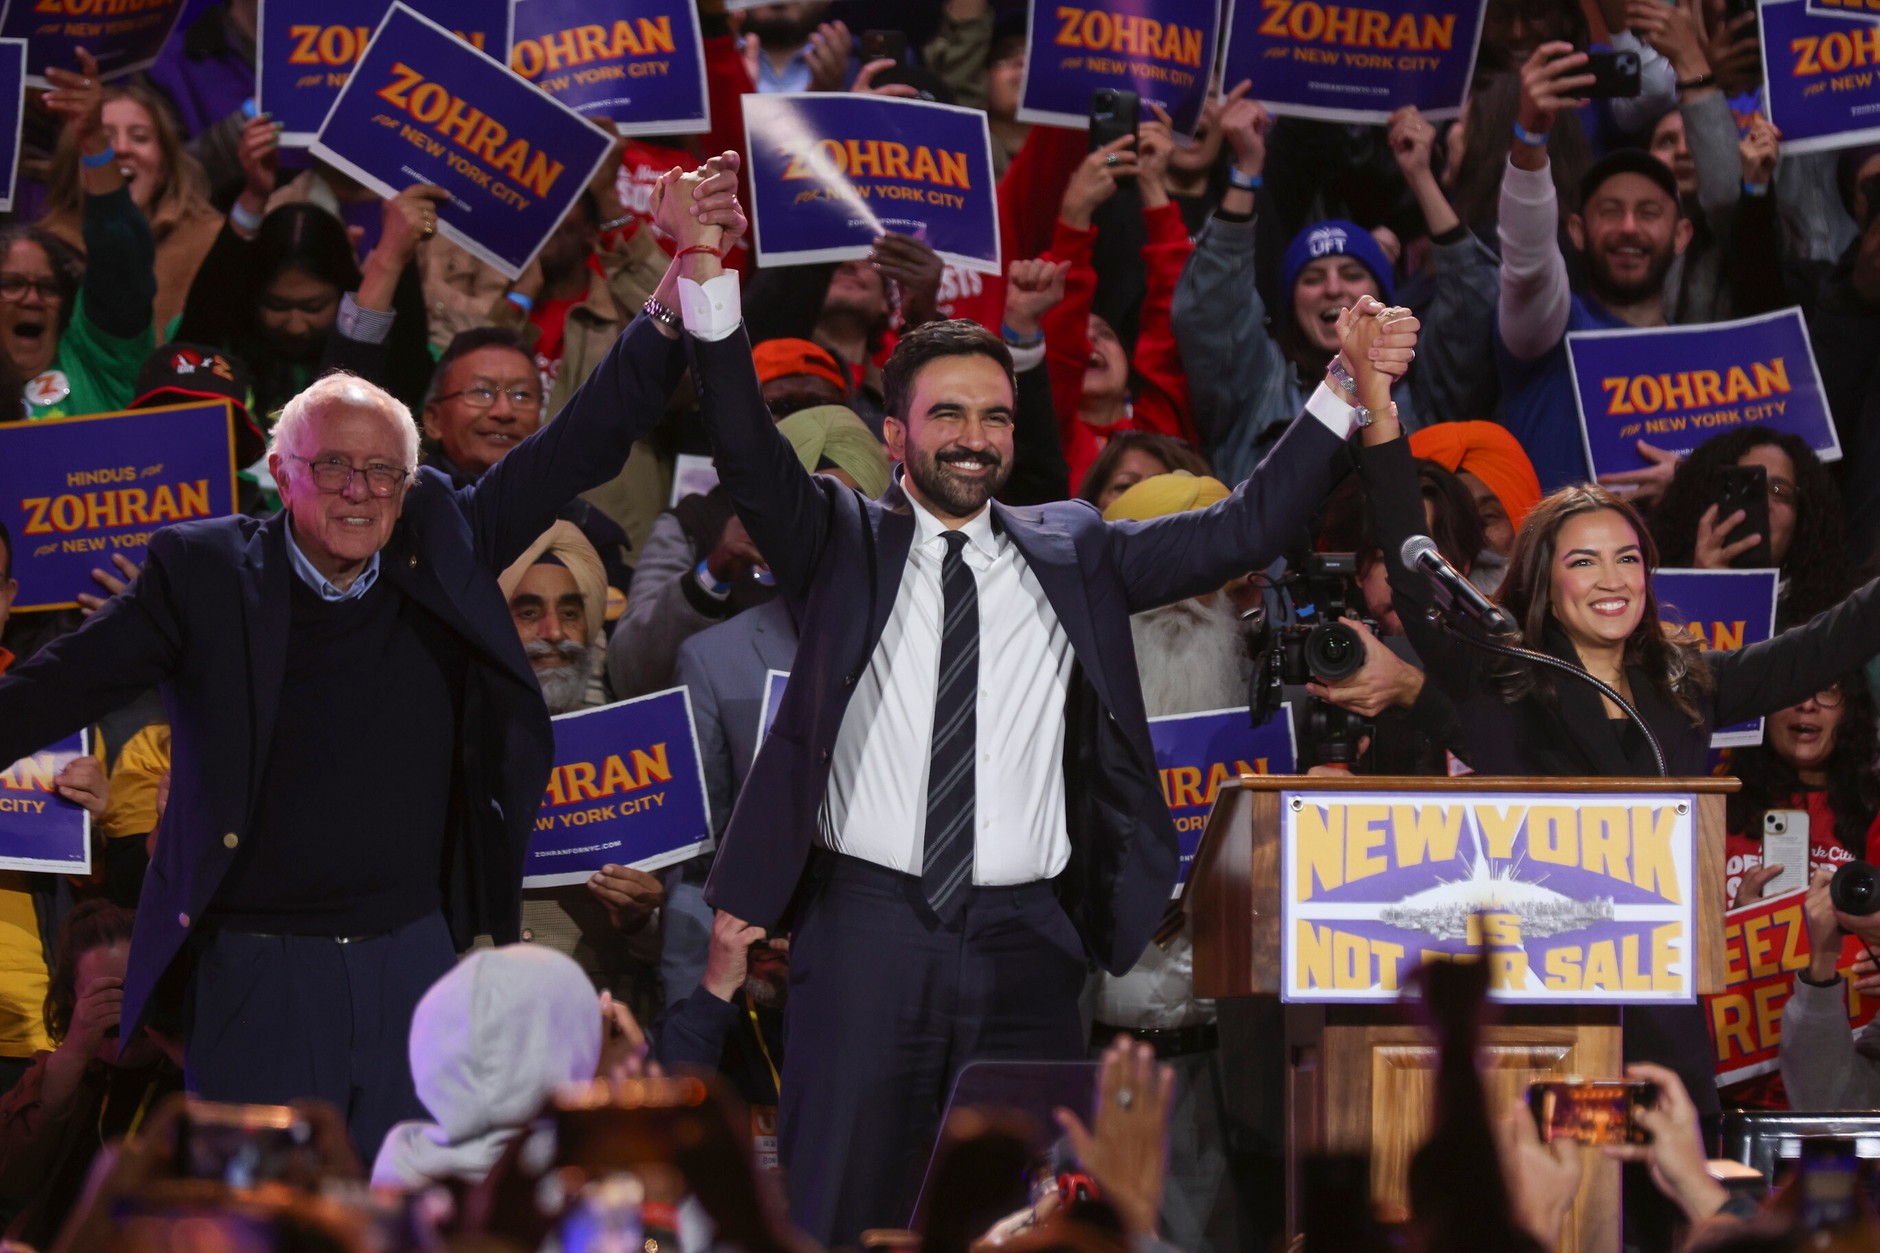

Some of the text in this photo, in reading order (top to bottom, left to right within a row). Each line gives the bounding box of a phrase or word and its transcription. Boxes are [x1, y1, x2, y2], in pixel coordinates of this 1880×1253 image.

[1055, 6, 1203, 68] ZOHRAN
[1255, 0, 1457, 50] ZOHRAN
[512, 15, 676, 80] OHRAN
[1293, 47, 1339, 65] NEW
[1343, 51, 1393, 69] YORK
[1397, 56, 1441, 71] CITY
[1790, 26, 1880, 77] ZOH
[536, 61, 670, 95] EW YORK CITY
[1087, 55, 1127, 75] NEW
[1129, 62, 1169, 80] YORK
[1169, 68, 1195, 88] CITY
[1830, 71, 1873, 93] NEW
[375, 61, 565, 198] ZOHRAN
[399, 124, 447, 158] NEW
[446, 151, 495, 189] YORK
[490, 181, 531, 213] CITY
[780, 138, 971, 190] ZOHRAN
[825, 184, 872, 201] NW
[874, 185, 926, 204] YORK
[926, 190, 966, 210] CITY
[1308, 237, 1347, 258] UFT
[34, 373, 60, 397] Z
[1601, 356, 1793, 416] ZOHRAN
[1645, 415, 1687, 435] NEW
[1690, 408, 1742, 429] YORK
[1743, 400, 1787, 422] CITY
[67, 466, 137, 488] HINDUS
[20, 478, 212, 536] ZOHRAN
[62, 536, 106, 553] NEW
[109, 531, 154, 549] YOR
[540, 742, 673, 808] HRAN
[0, 797, 46, 814] CITY
[559, 804, 617, 828] YORK
[619, 791, 666, 816] CITY
[1173, 815, 1209, 833] OR
[534, 840, 622, 858] ZOHRANFORNYC.COM
[1296, 803, 1465, 904] NEW
[1474, 804, 1682, 905] YORK
[1466, 911, 1521, 946] IS
[1725, 904, 1811, 988] EEZ
[1296, 918, 1404, 991] NOT
[1544, 920, 1683, 991] SALE
